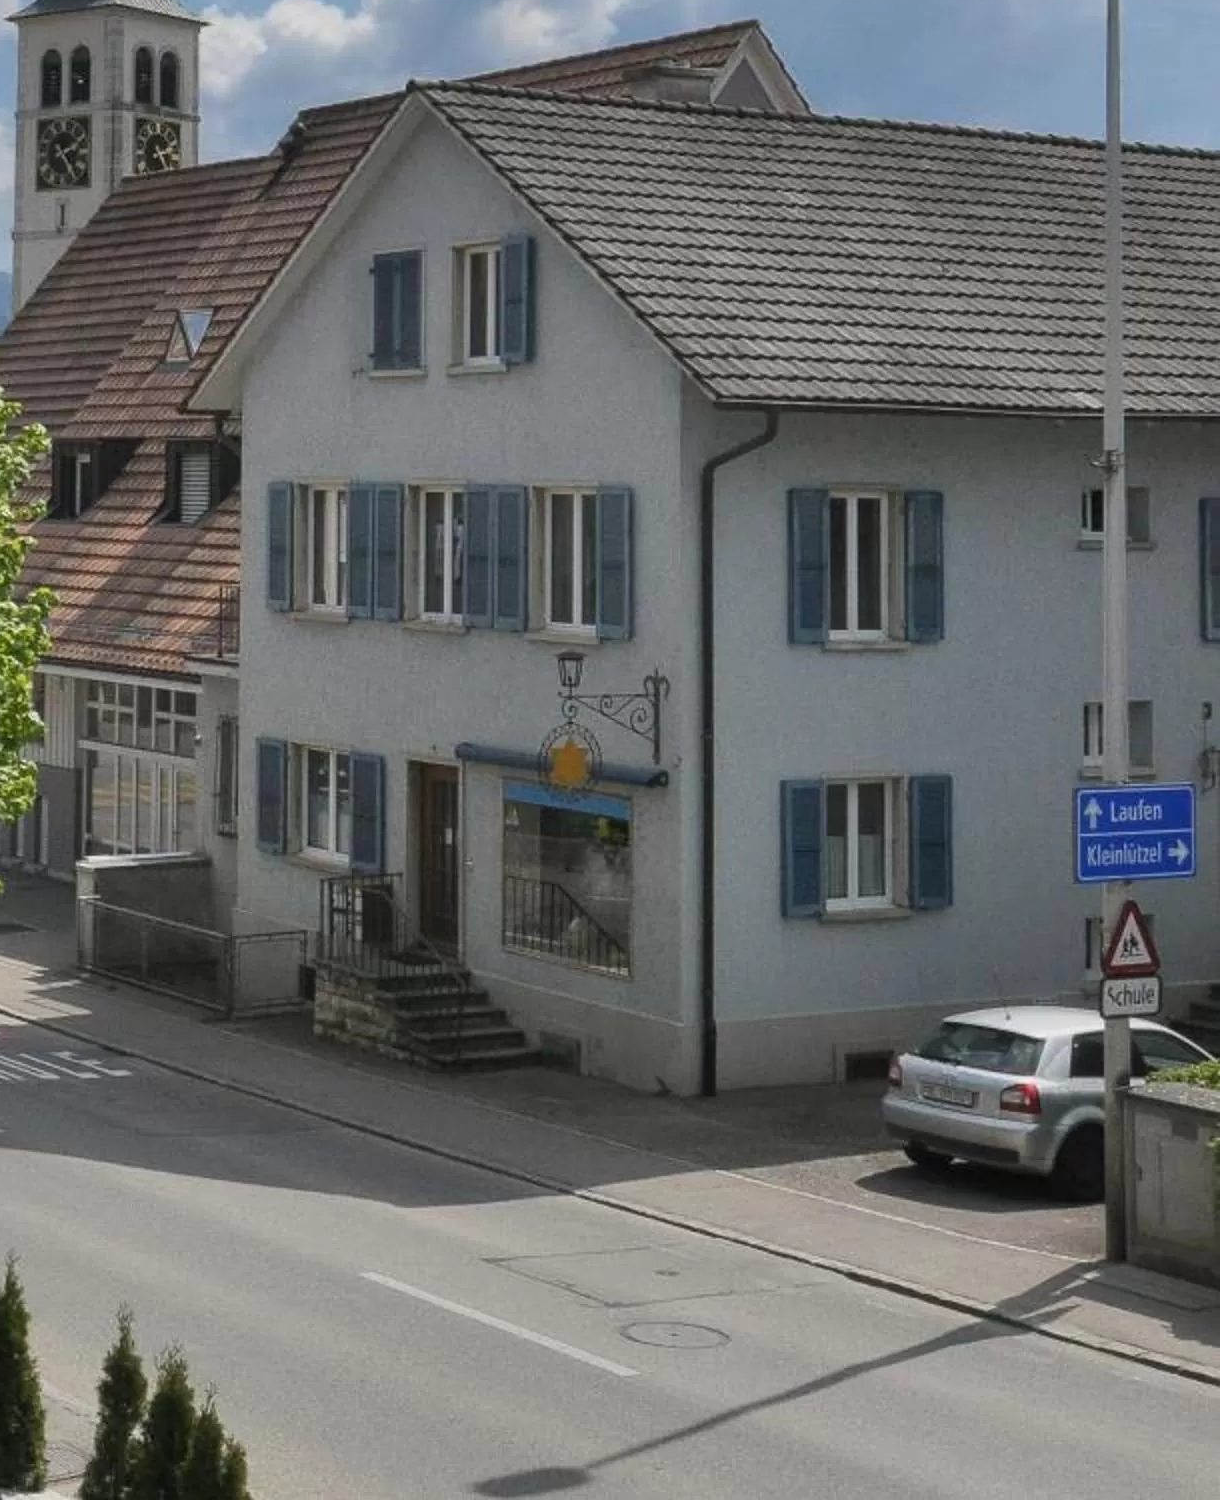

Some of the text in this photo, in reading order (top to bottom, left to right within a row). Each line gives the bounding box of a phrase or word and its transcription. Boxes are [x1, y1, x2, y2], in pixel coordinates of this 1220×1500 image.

[1110, 799, 1163, 823] Laufen
[1087, 842, 1162, 866] Kleinlützel
[1107, 983, 1155, 1007] Schule
